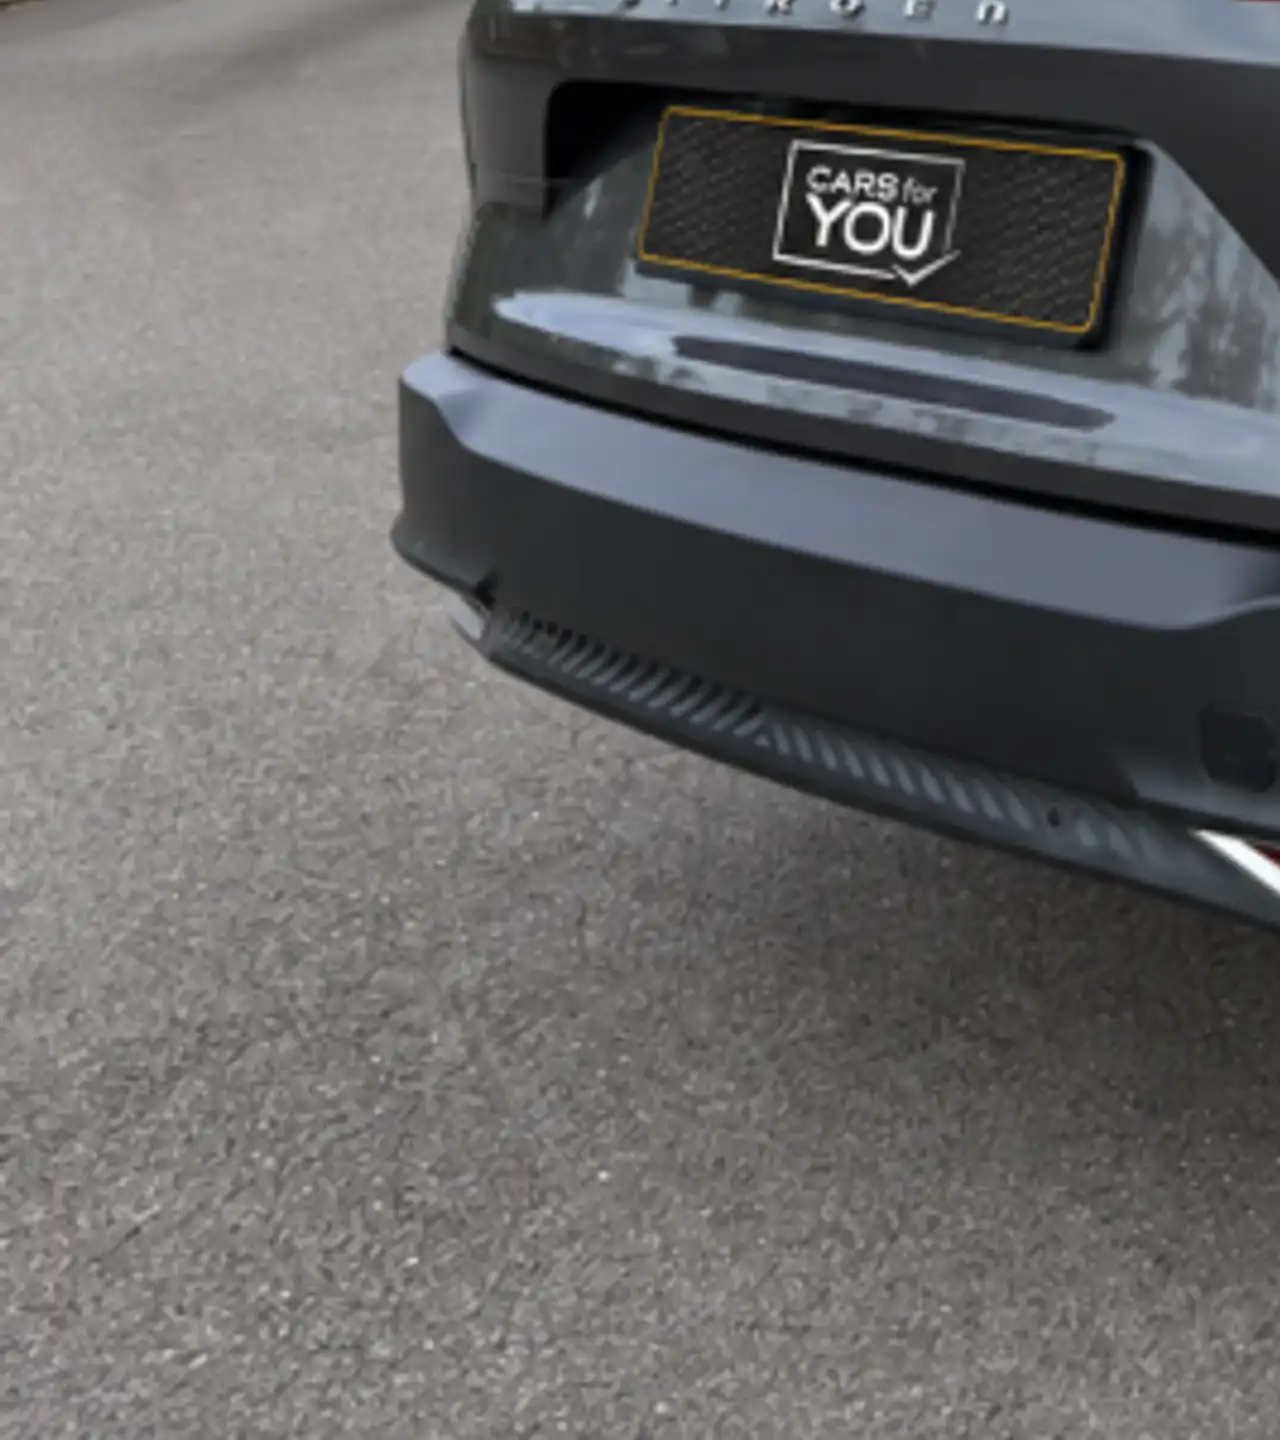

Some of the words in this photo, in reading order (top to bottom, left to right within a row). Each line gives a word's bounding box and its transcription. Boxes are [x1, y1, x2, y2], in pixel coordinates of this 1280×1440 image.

[806, 164, 899, 202] CARS
[902, 175, 938, 206] for
[805, 192, 935, 260] YOU
